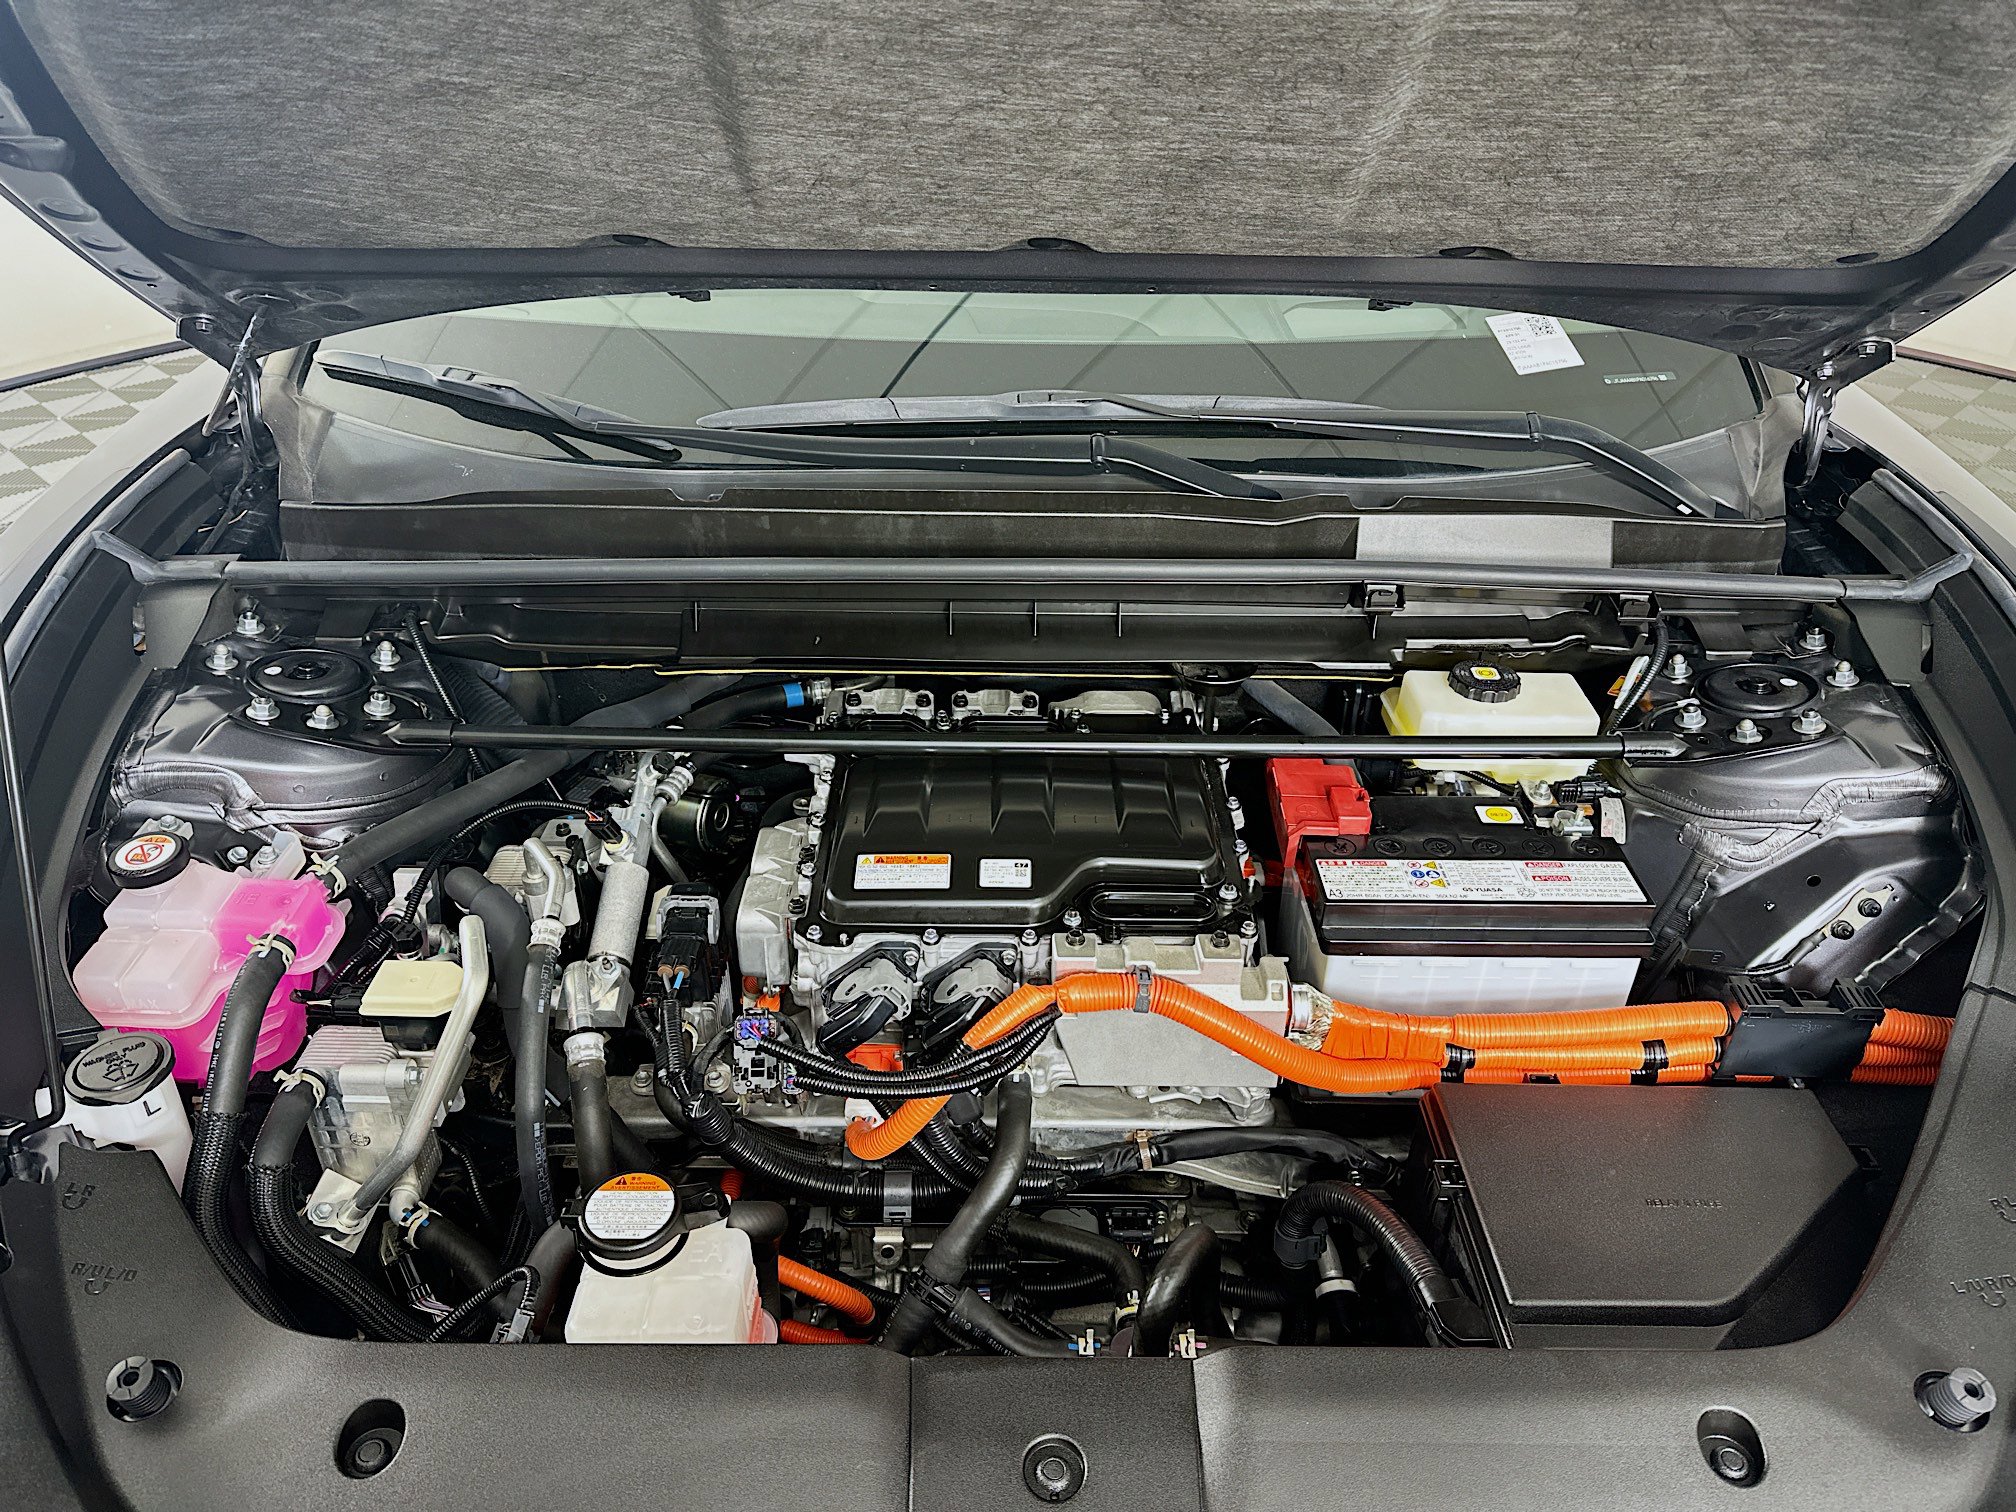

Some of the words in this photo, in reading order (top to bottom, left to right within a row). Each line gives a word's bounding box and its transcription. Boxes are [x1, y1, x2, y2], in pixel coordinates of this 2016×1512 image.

[1329, 889, 1344, 898] A3
[143, 1100, 162, 1117] L
[1645, 1198, 1680, 1208] RELAY
